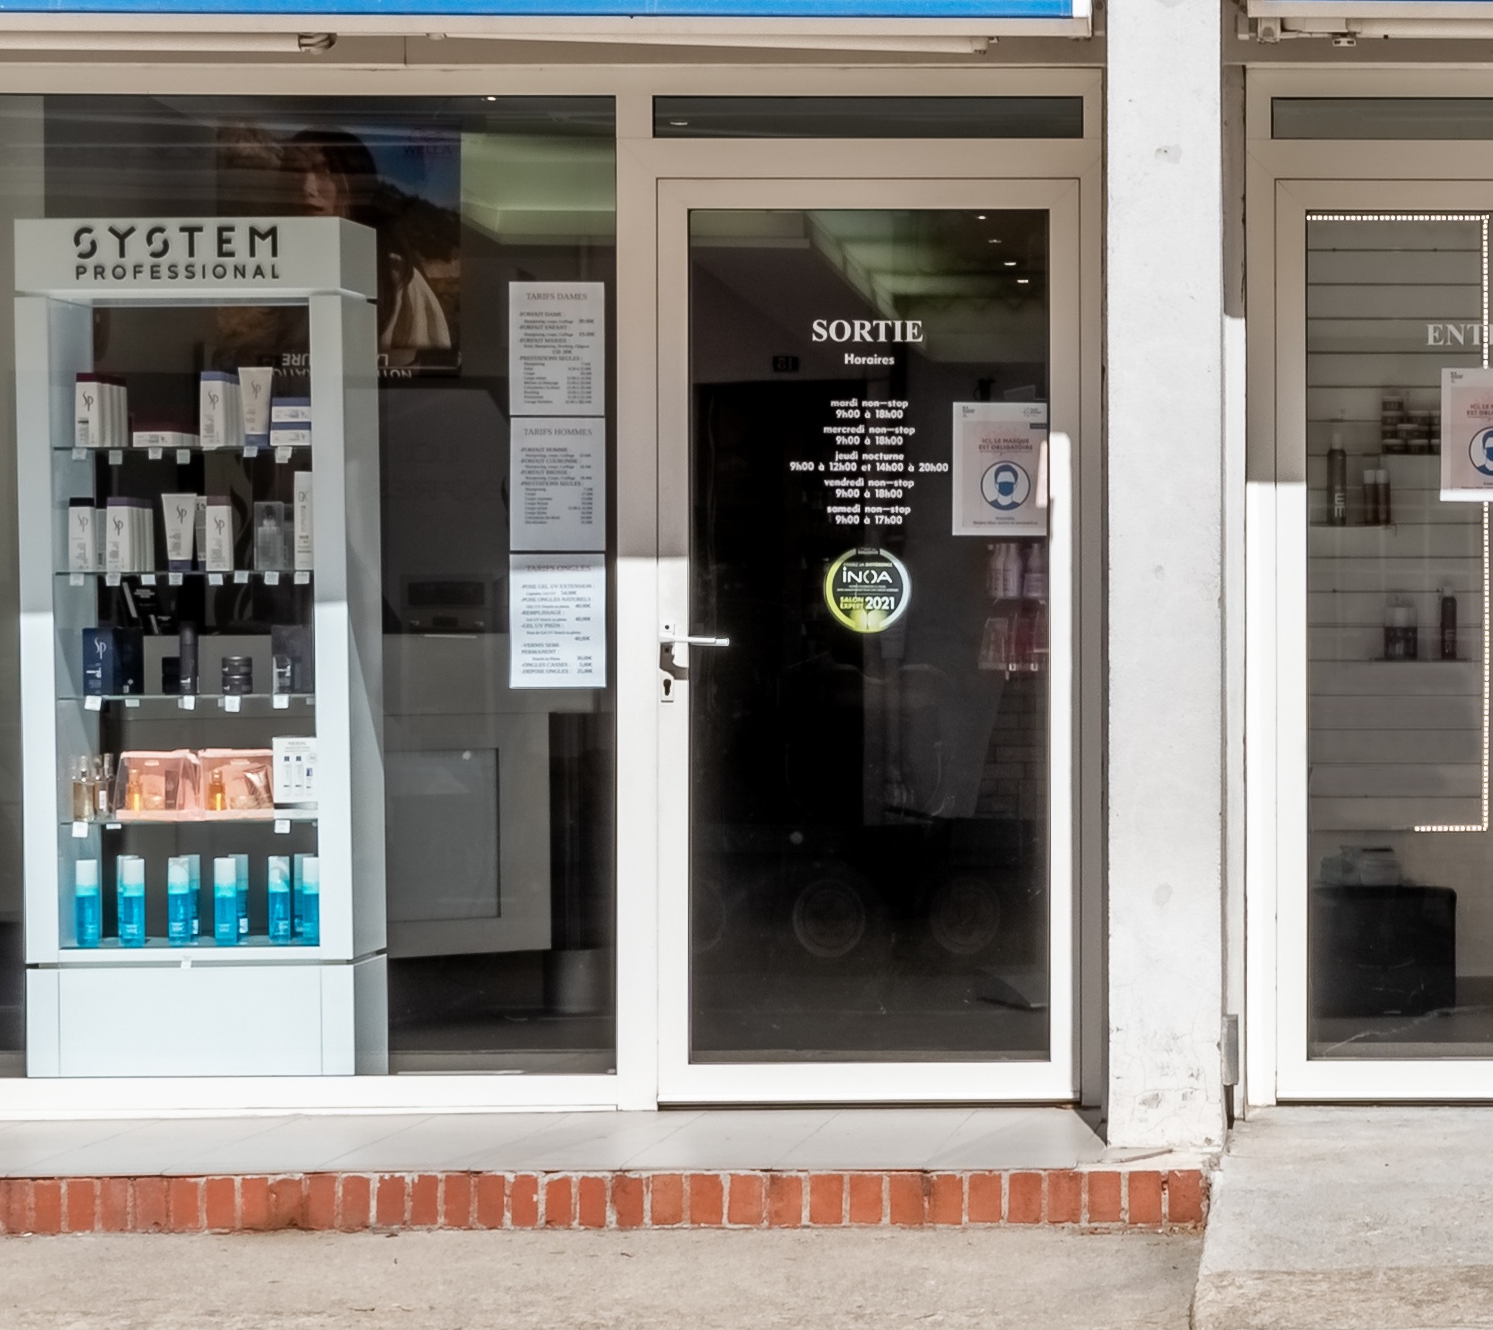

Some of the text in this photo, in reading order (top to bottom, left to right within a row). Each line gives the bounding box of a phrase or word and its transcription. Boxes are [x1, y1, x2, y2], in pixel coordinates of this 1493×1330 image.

[73, 225, 279, 260] SYSTEM
[75, 263, 280, 280] PROFESSIONAL
[812, 319, 924, 343] SORTIE
[844, 353, 895, 365] Horaires
[830, 398, 858, 407] mardi
[835, 409, 903, 419] 9h00 à 18h00
[554, 428, 593, 436] HOMMES
[823, 424, 865, 434] mercredi
[835, 436, 903, 445] 9h00 à 18h00
[835, 451, 904, 461] jeudi nocturne
[789, 461, 949, 472] 9h00 à 12h00 et 14h00 à 20h00
[824, 477, 864, 487] vendredi
[835, 489, 903, 498] 9h00 à 18h00
[826, 504, 861, 513] samedi
[835, 515, 903, 525] 9h00 à 17h00
[865, 596, 895, 610] 2021
